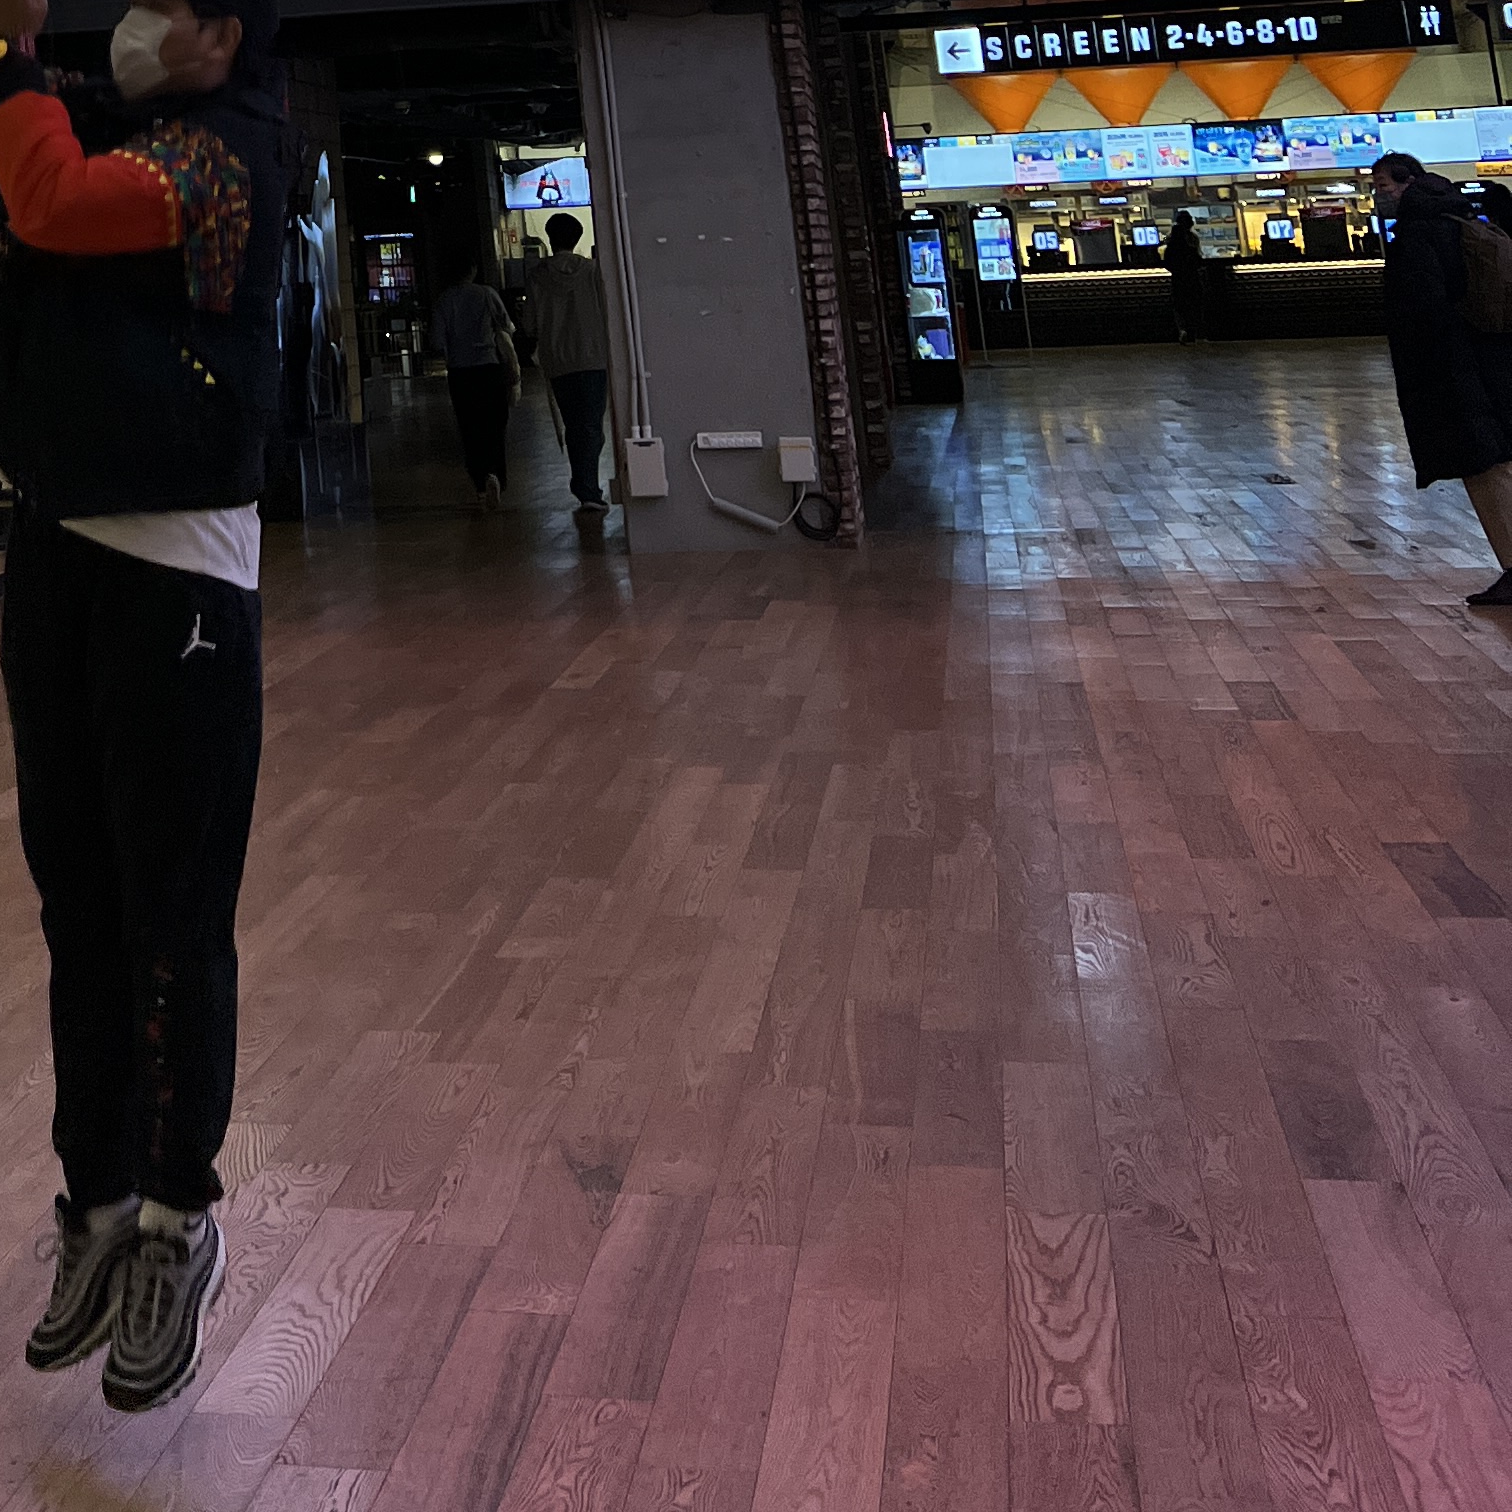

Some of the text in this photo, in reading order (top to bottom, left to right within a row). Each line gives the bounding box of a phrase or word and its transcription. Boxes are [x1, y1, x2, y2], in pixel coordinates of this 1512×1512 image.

[985, 26, 1151, 61] SCREEN
[1135, 227, 1158, 245] 06
[1268, 221, 1292, 238] 07
[1035, 232, 1058, 249] 05
